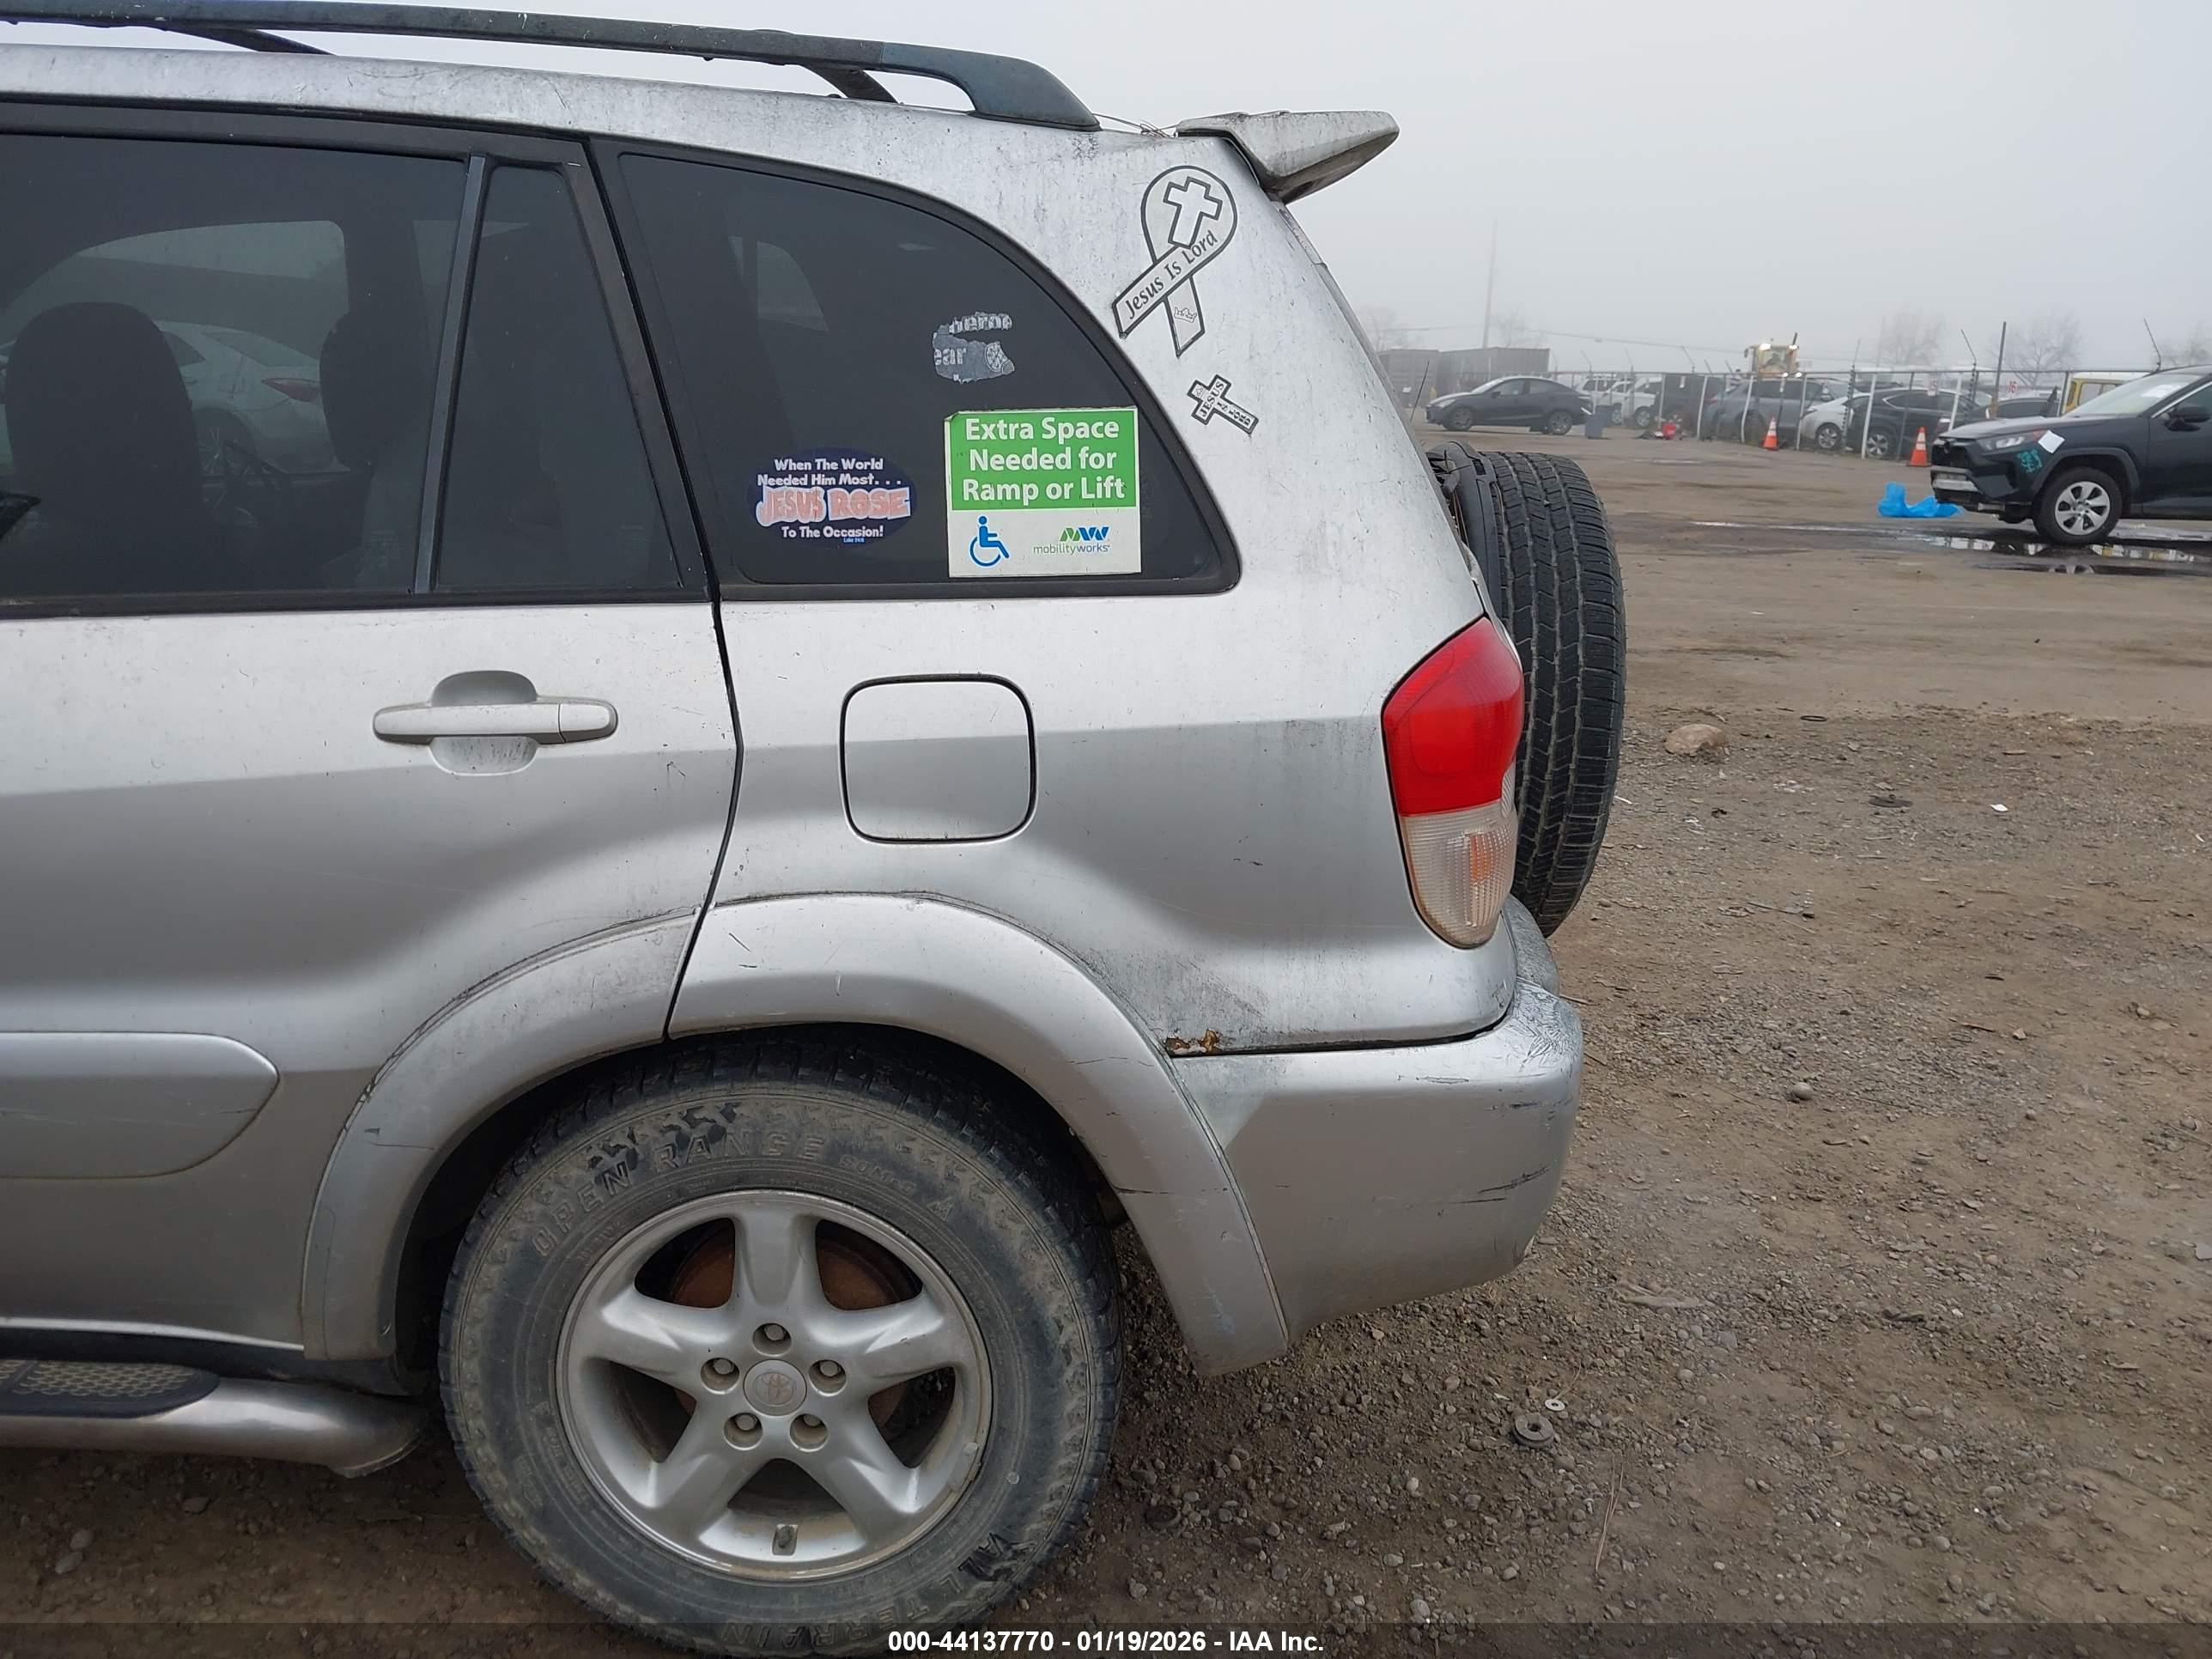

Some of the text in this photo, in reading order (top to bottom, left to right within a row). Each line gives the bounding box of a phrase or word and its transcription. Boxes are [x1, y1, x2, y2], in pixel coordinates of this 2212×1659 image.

[1124, 229, 1218, 319] Jesus Is Lord
[1199, 380, 1224, 418] JESUS
[964, 416, 1120, 445] Extra Space
[774, 457, 884, 471] When The World
[969, 446, 1116, 471] Needed for
[757, 473, 808, 486] Needed
[811, 473, 836, 486] Him
[962, 475, 1126, 507] Ramp or Lift
[756, 485, 911, 526] JESUS ROSE
[781, 525, 884, 538] To The Occasion!
[532, 1160, 634, 1257] OPEN
[652, 1130, 827, 1171] RANGE
